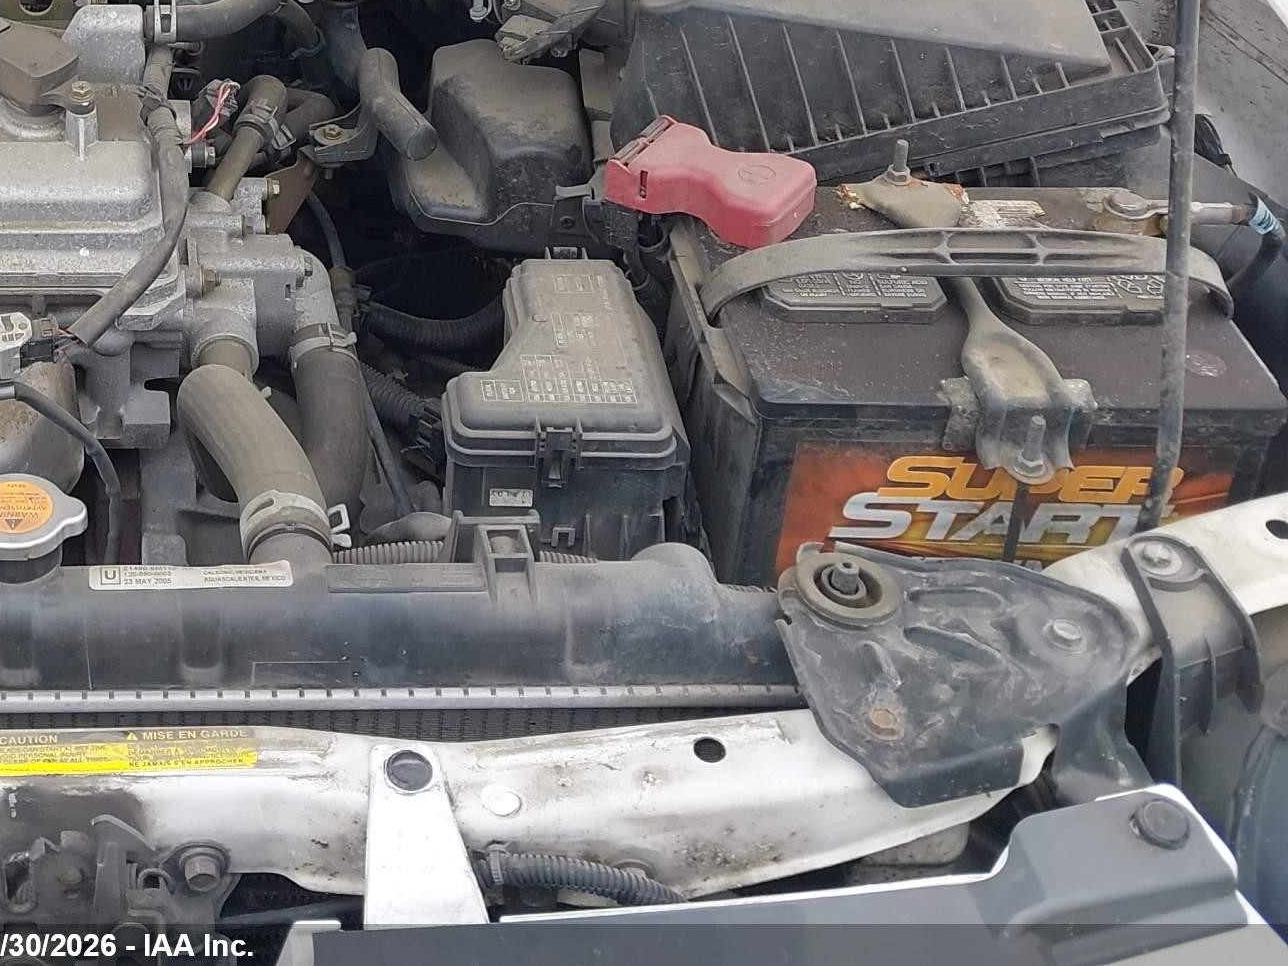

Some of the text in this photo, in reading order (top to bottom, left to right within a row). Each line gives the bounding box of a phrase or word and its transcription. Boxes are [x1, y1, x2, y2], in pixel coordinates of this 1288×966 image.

[828, 491, 1177, 545] START
[135, 578, 152, 586] MAY
[154, 577, 172, 585] 2005
[143, 729, 249, 741] MISE EN GARDE
